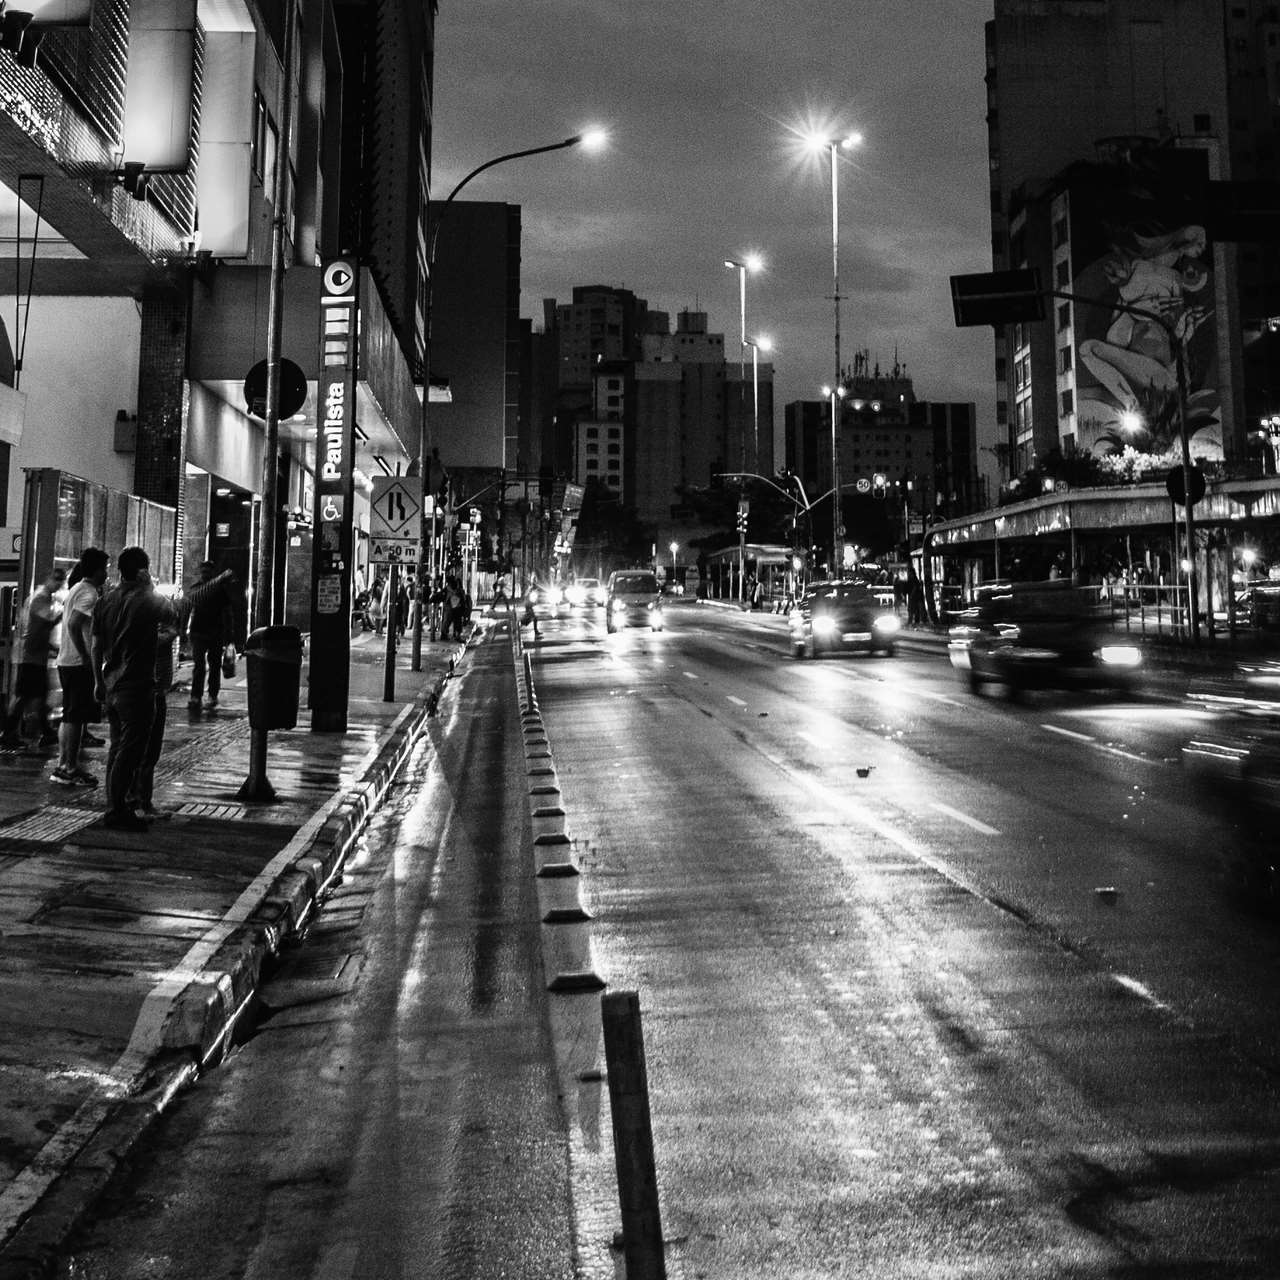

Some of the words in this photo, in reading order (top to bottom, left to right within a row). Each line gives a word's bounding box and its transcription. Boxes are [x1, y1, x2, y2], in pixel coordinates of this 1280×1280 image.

[323, 382, 345, 480] Paulista
[374, 545, 382, 555] A
[389, 545, 402, 556] 50
[405, 548, 415, 556] m
